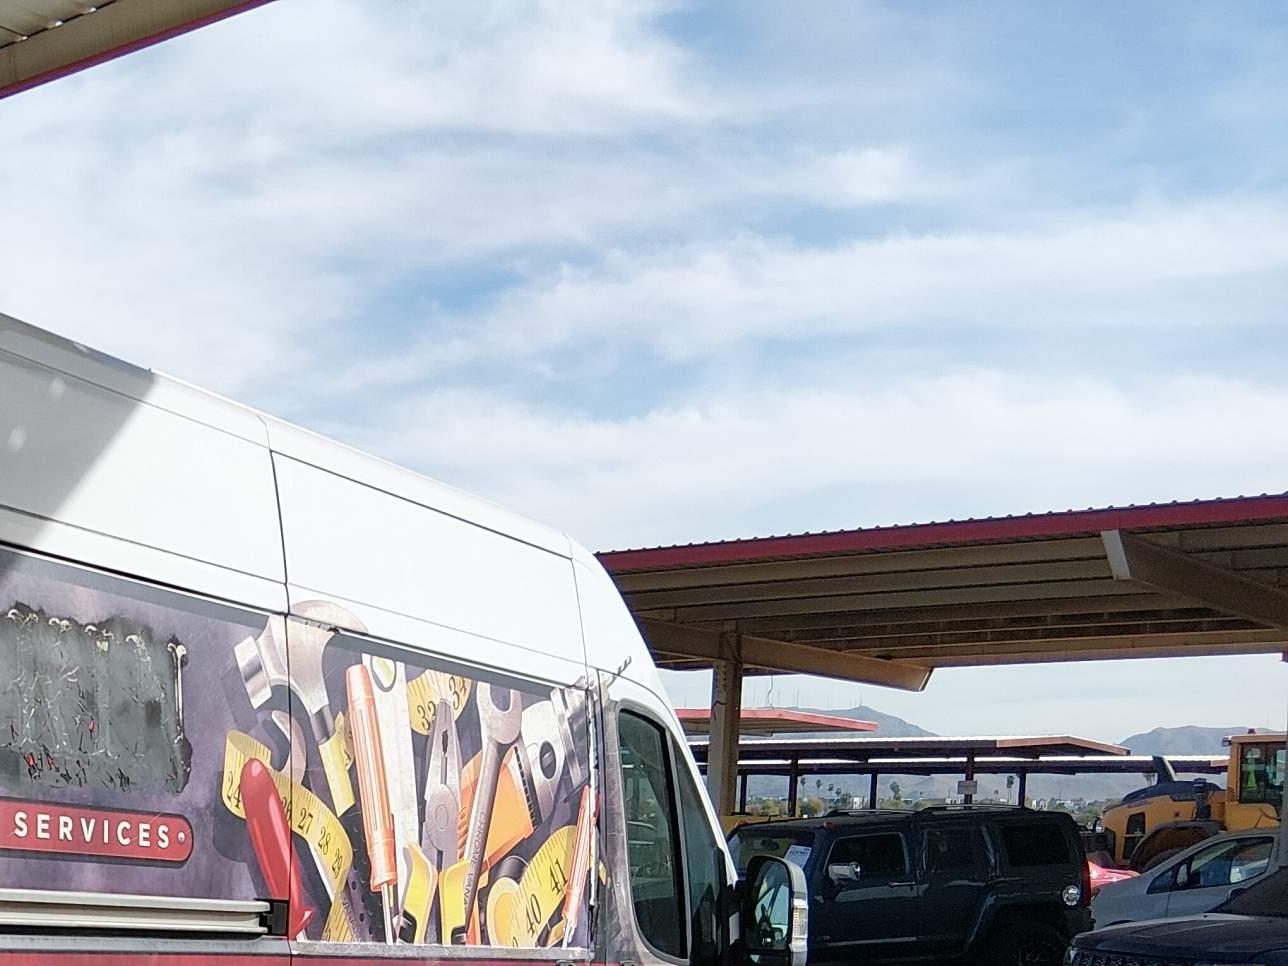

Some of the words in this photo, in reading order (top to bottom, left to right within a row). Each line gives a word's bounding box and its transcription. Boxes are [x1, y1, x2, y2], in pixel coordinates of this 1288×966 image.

[13, 812, 170, 849] SERVICES
[298, 807, 314, 835] 27
[318, 826, 331, 855] 28
[331, 848, 343, 879] 29
[549, 857, 569, 897] 41
[525, 893, 542, 938] 40
